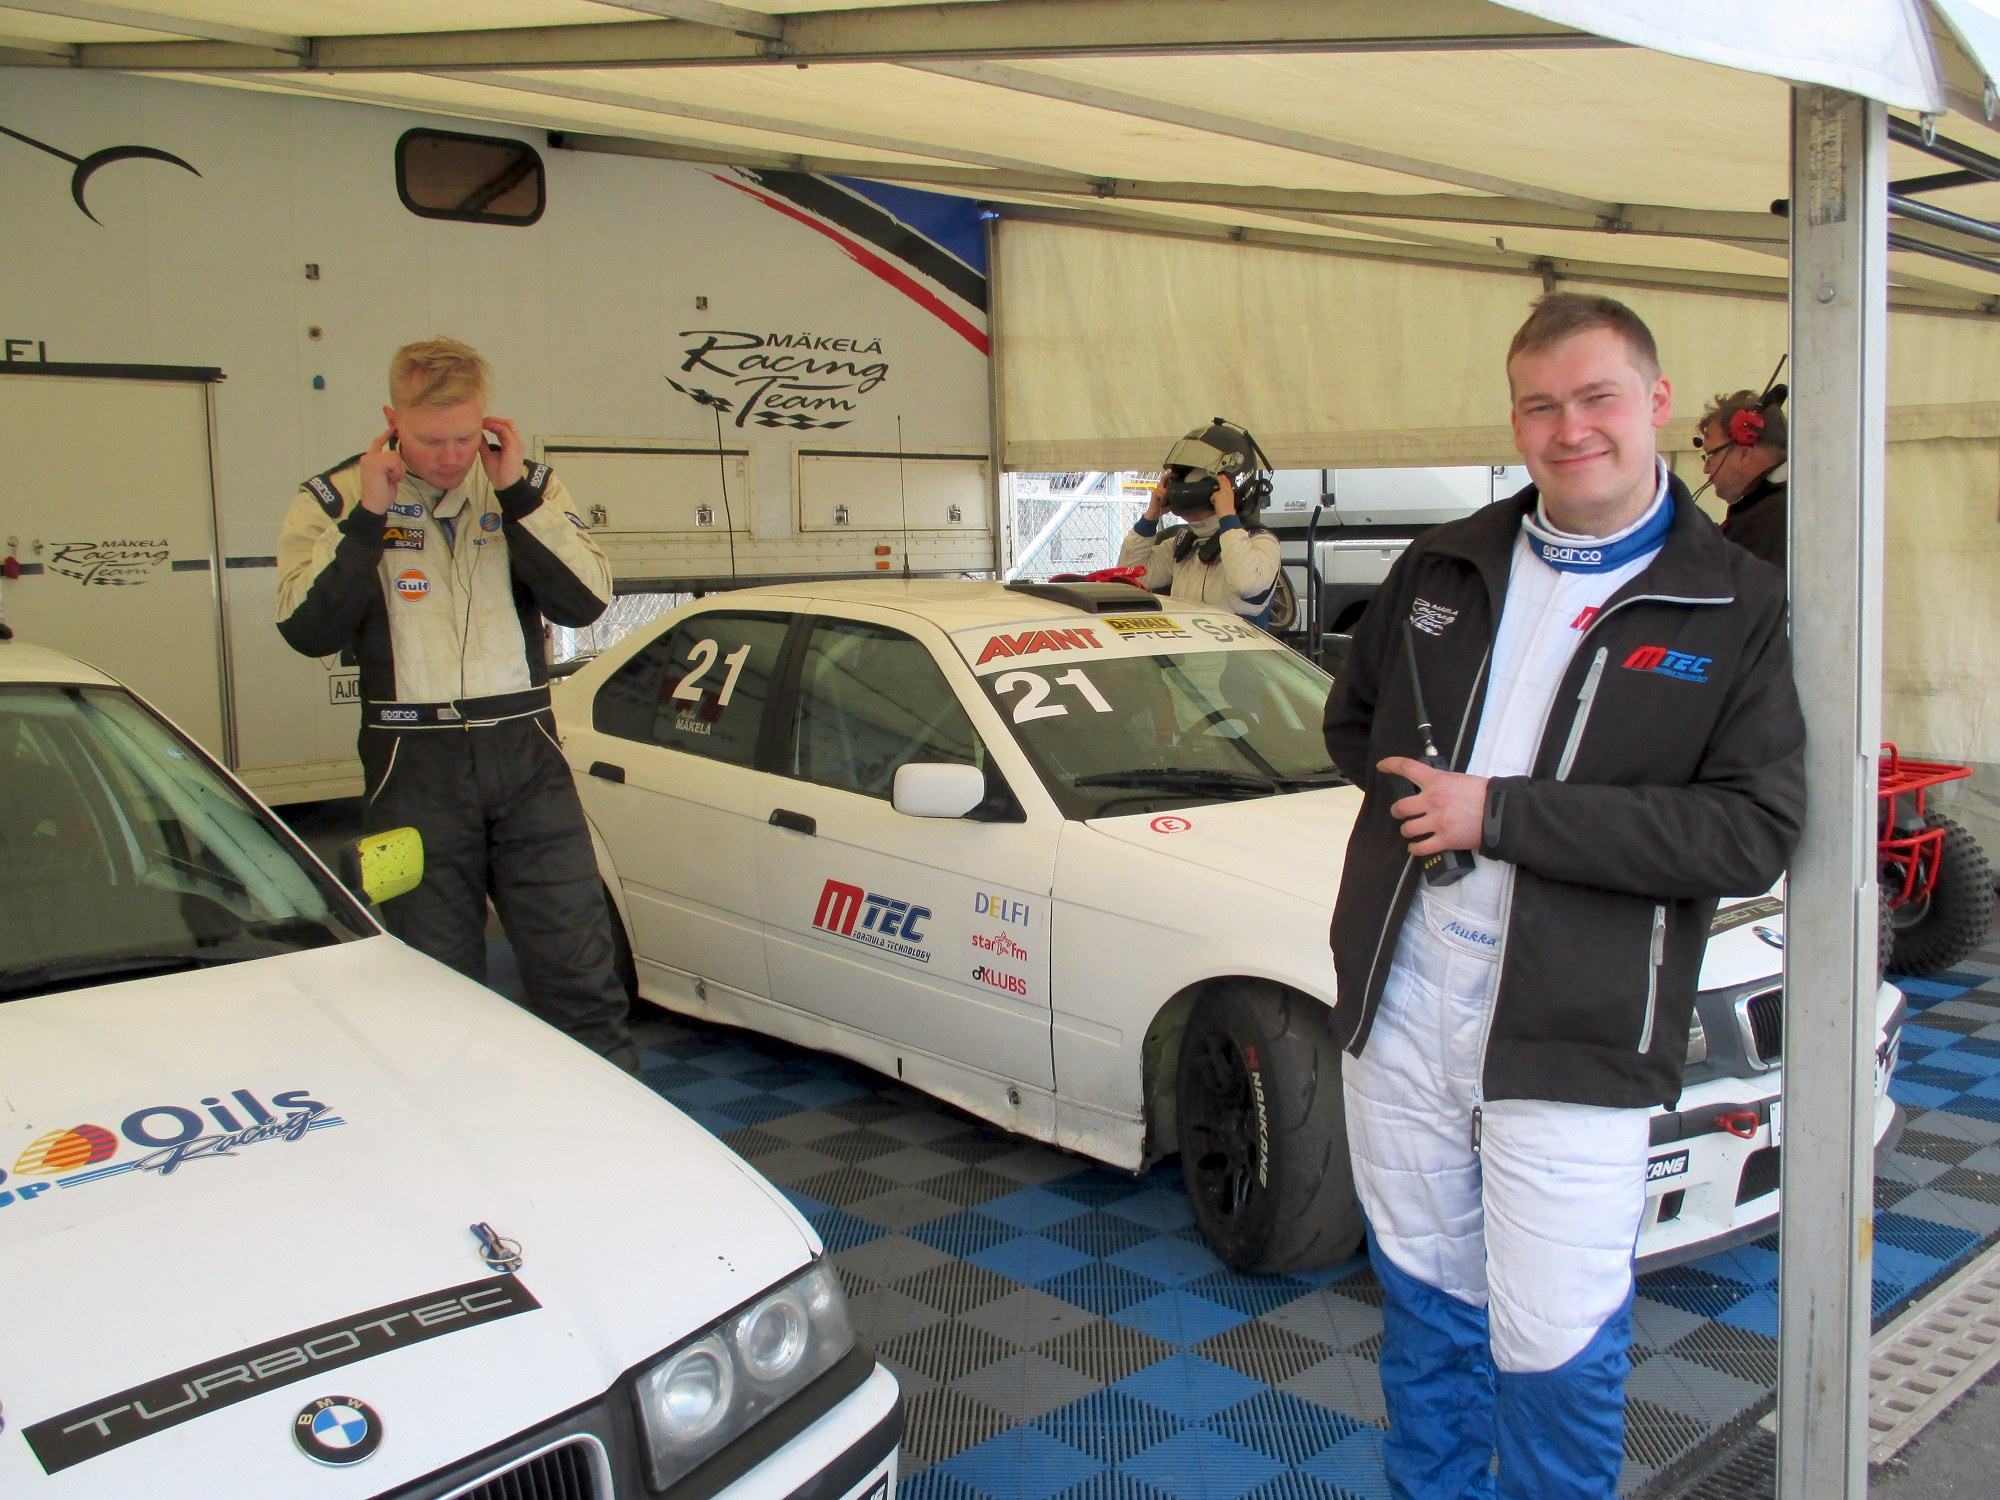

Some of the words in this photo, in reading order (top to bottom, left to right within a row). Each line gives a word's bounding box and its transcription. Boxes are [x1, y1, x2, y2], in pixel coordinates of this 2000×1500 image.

[766, 333, 882, 354] MÄKELÄ
[678, 330, 889, 393] Racing
[735, 375, 857, 428] Team
[50, 542, 170, 566] Racing
[101, 539, 169, 548] MÄKELÄ
[395, 540, 422, 549] sport
[1542, 544, 1602, 562] sparco
[81, 560, 150, 586] Team
[396, 580, 429, 591] Gulf
[975, 629, 1103, 666] AVANT
[1118, 630, 1193, 641] FTCC
[672, 638, 752, 707] 21
[1622, 645, 1712, 673] MTEC
[994, 668, 1113, 724] 21
[381, 709, 417, 720] sparco
[675, 719, 711, 736] MÄKELÄ
[812, 878, 933, 944] MTEC
[974, 891, 1030, 927] DELFI
[853, 930, 885, 947] FORMULA
[887, 940, 931, 960] TECHNOLOGY
[971, 934, 996, 952] star
[1011, 942, 1028, 961] fm
[982, 968, 1027, 996] KLUBS
[121, 1088, 327, 1148] Oils
[1251, 1071, 1269, 1190] NANKANG
[130, 1106, 334, 1176] Racing
[62, 1286, 514, 1438] TURBOTEC
[297, 1396, 364, 1427] BMW
